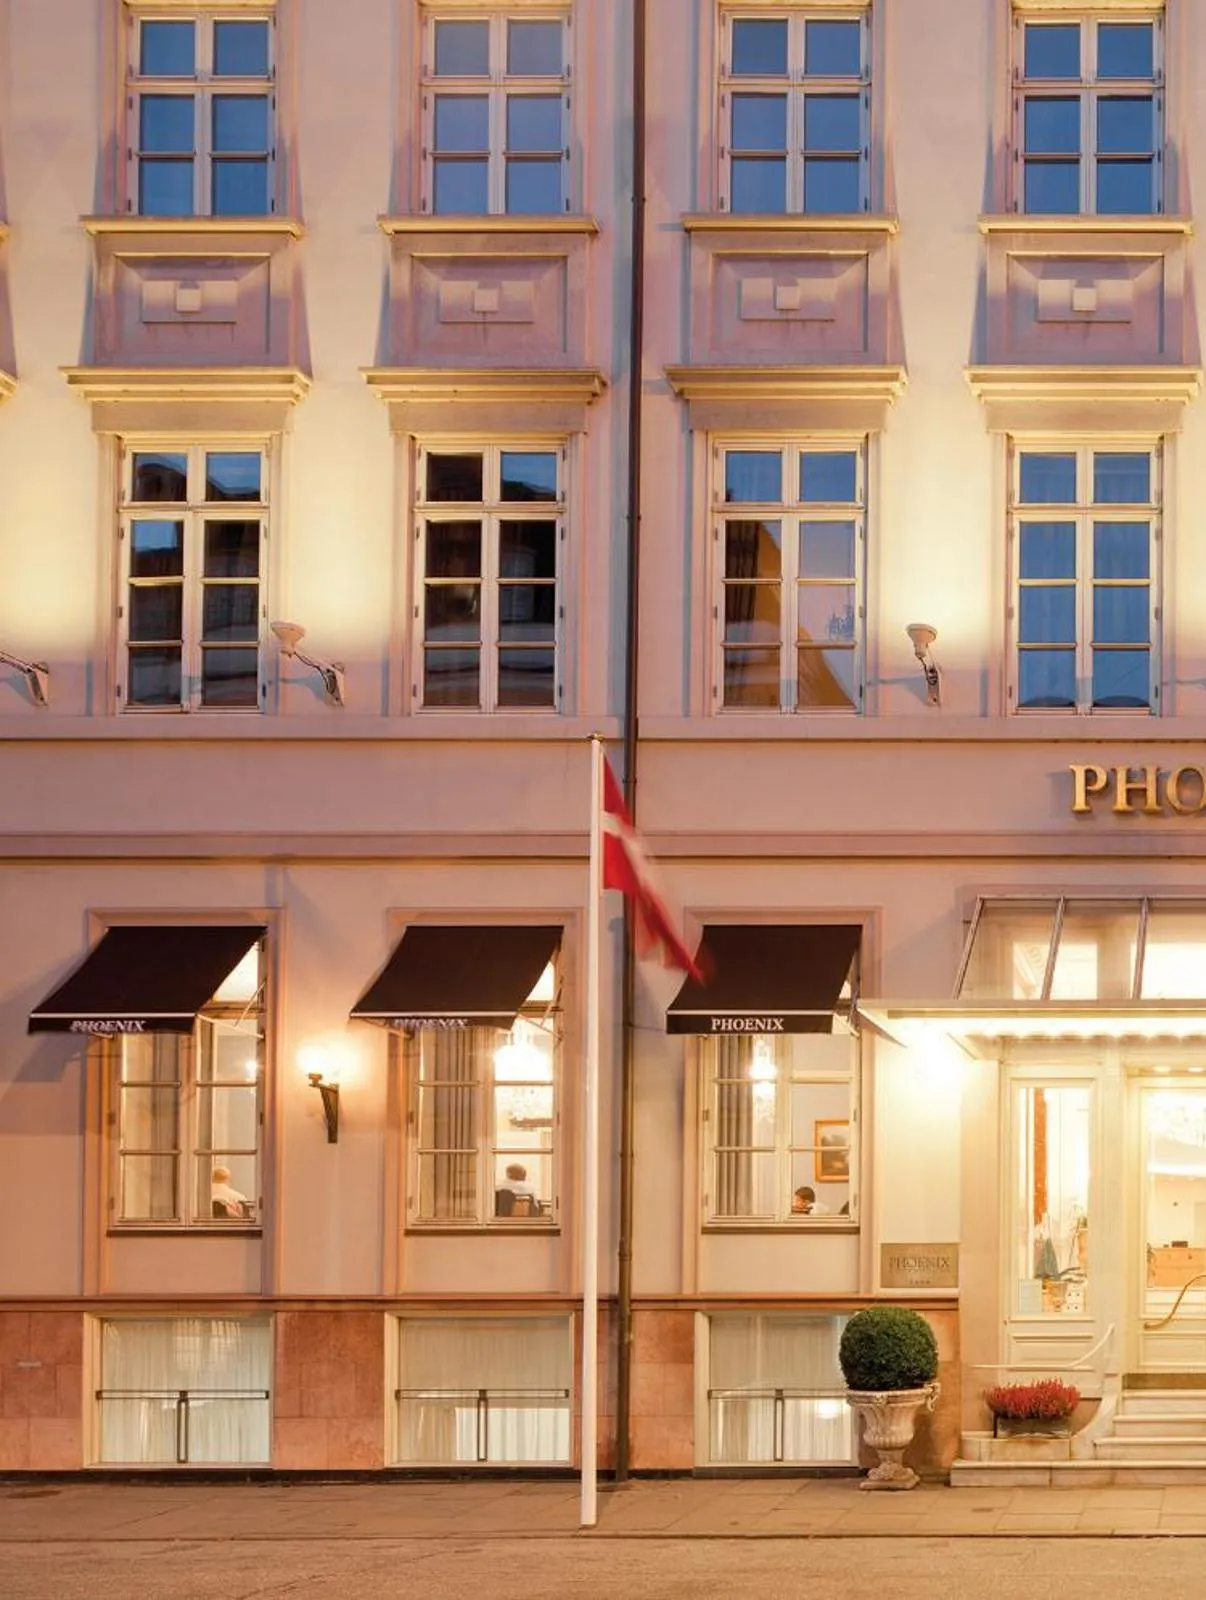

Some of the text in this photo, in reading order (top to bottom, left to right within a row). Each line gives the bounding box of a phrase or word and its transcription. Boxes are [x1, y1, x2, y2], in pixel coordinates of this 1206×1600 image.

[70, 1020, 146, 1032] PHOENIX
[711, 1018, 784, 1031] PHOENIX
[889, 1256, 951, 1268] PHOENIX
